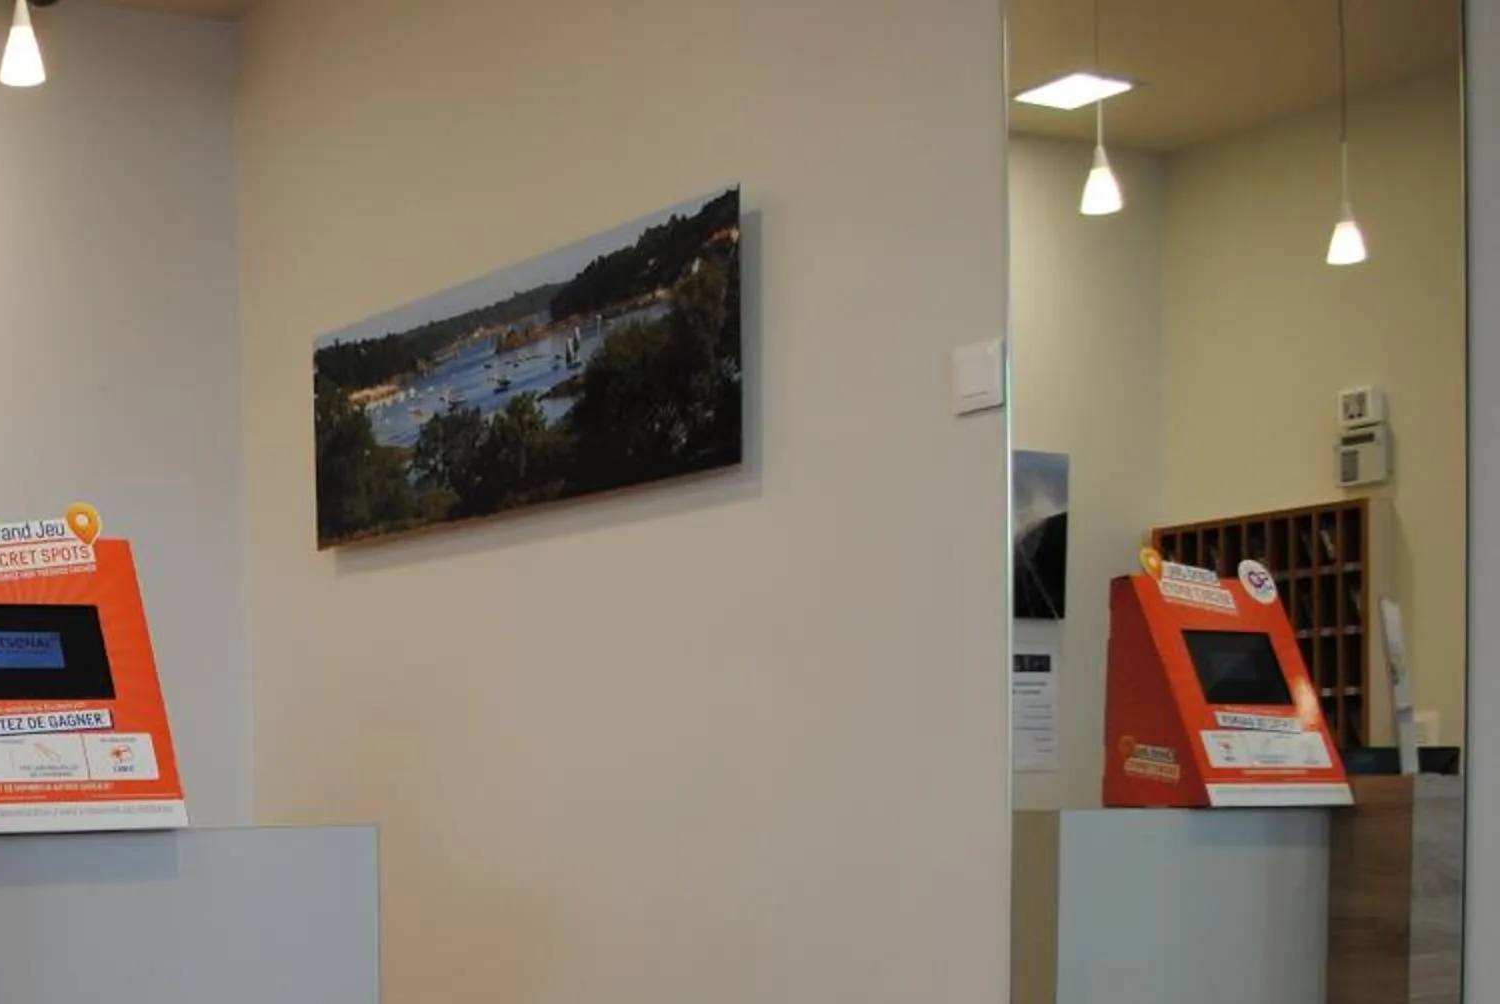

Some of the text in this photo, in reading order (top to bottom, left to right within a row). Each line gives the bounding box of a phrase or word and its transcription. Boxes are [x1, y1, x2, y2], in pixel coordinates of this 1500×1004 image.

[36, 519, 66, 538] Jeu
[41, 546, 91, 564] SPOTS
[28, 716, 45, 729] DE
[49, 713, 102, 728] GAGNER
